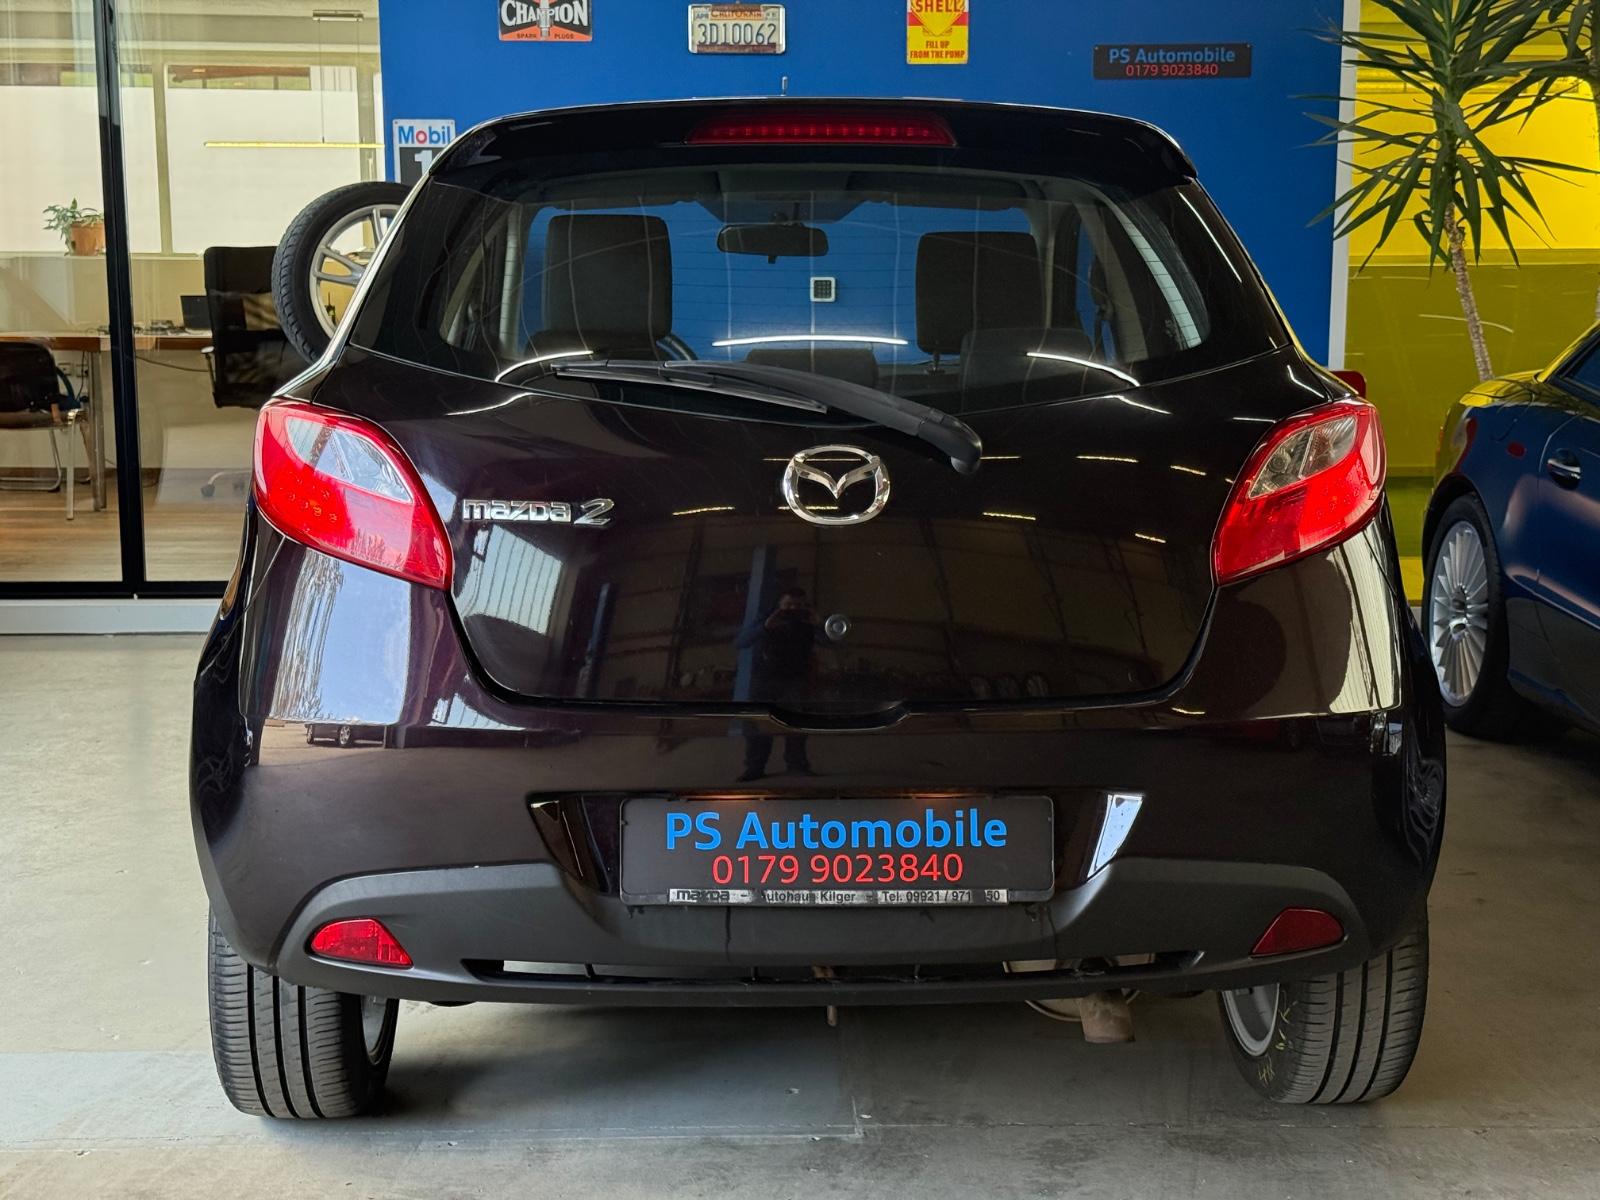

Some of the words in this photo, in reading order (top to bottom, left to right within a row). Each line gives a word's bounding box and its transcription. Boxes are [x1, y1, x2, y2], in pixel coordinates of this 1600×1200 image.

[915, 0, 961, 12] SHELL
[698, 23, 776, 45] 3D10062
[1108, 48, 1130, 63] PS
[1134, 47, 1236, 63] Automobile
[1125, 64, 1159, 77] 0179
[1161, 63, 1219, 76] 9023840
[398, 126, 450, 145] Mobil
[666, 811, 722, 850] PS
[736, 808, 1008, 849] Automobile
[712, 855, 799, 885] 0179
[810, 853, 964, 883] 9023840
[760, 890, 815, 902] utohau
[820, 890, 856, 903] Kilger
